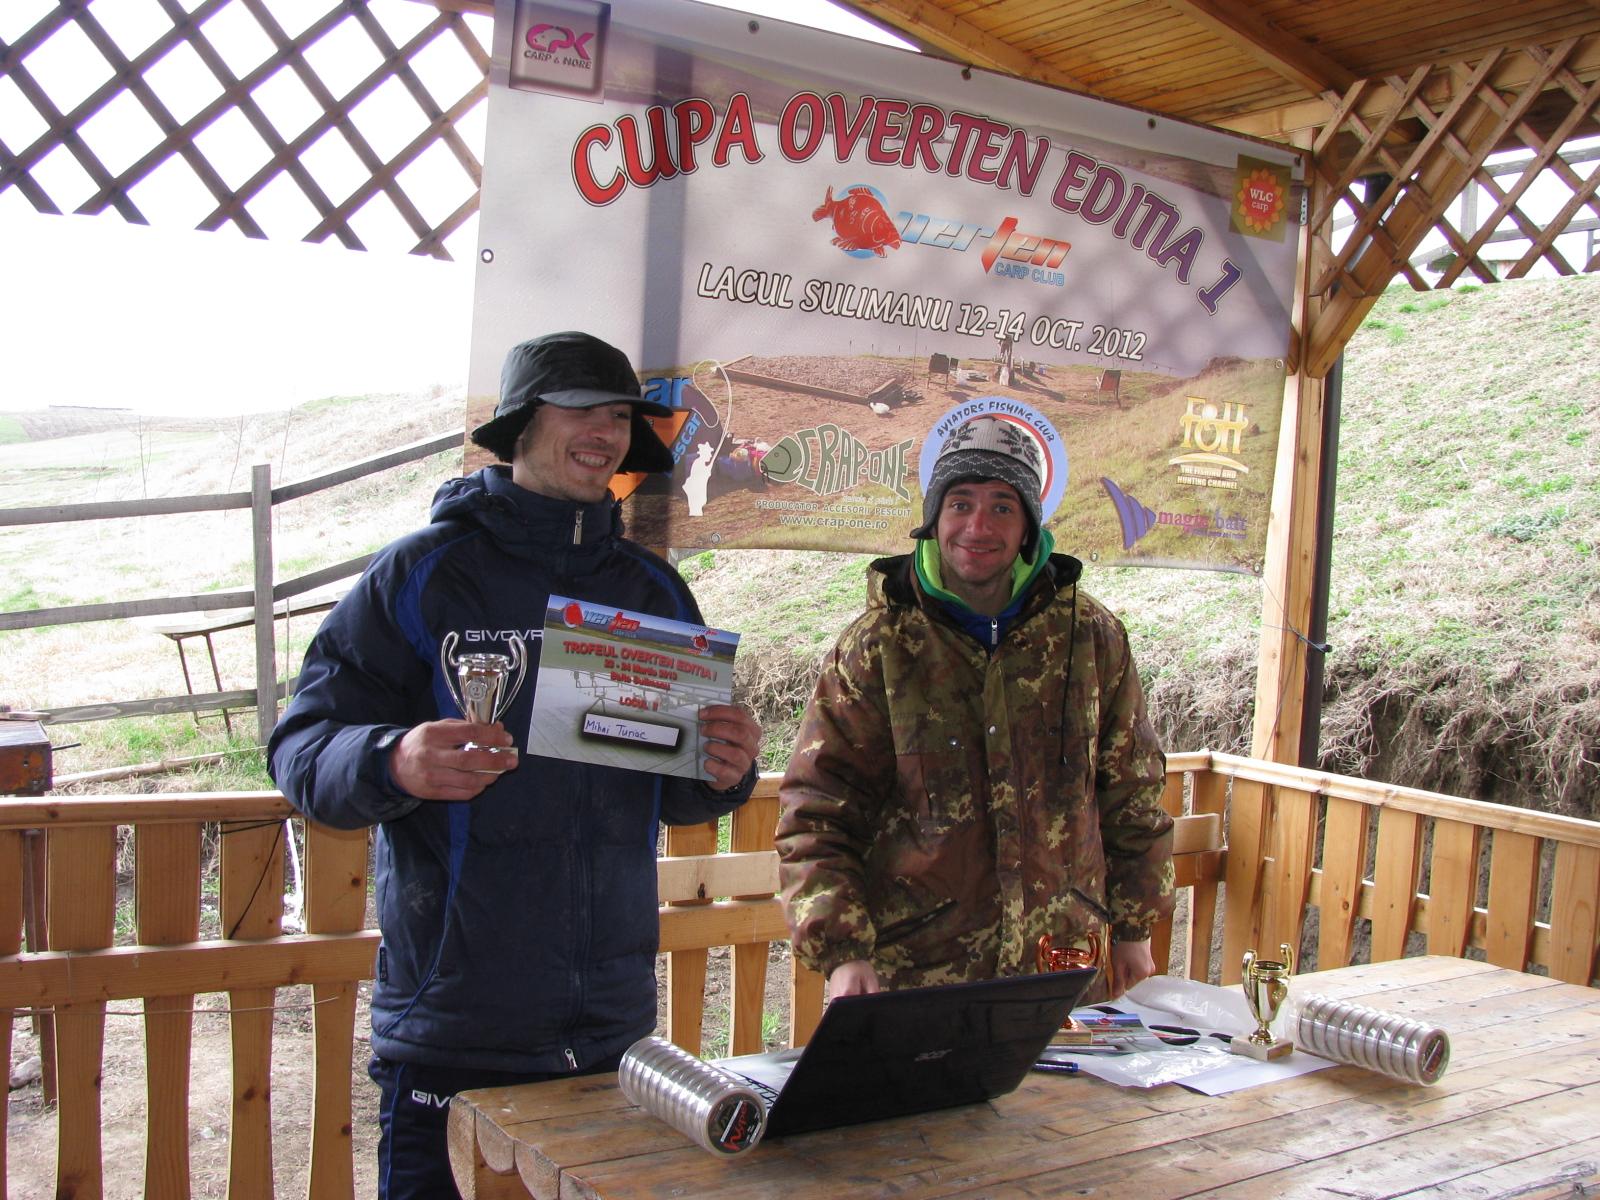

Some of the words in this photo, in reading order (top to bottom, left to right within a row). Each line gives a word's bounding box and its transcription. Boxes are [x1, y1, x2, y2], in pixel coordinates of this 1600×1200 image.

[524, 50, 552, 61] CARP
[571, 93, 765, 207] CUPA
[778, 91, 1051, 197] OVERTEN
[1051, 150, 1204, 284] EDITIA
[1250, 188, 1274, 202] WLC
[1251, 201, 1269, 213] carp
[994, 262, 1030, 280] CARP
[1031, 268, 1066, 287] CLUB
[697, 263, 793, 308] LACUL
[799, 280, 952, 331] SULIMANU
[956, 304, 1024, 341] 12-14
[1031, 316, 1081, 351] OCT.
[1087, 324, 1148, 361] 2012
[645, 377, 692, 407] ar
[937, 402, 984, 438] AVIATORS
[988, 401, 1033, 421] FISHING
[1034, 420, 1055, 442] CLUB
[1177, 475, 1207, 486] HUNTING
[1207, 479, 1238, 490] CHANNEL
[756, 501, 817, 511] PRODUCATOR
[875, 507, 911, 518] PESCUIT
[563, 640, 618, 658] TROFEUL
[620, 647, 674, 669] OVERTEN
[584, 720, 610, 735] Mihai
[412, 1089, 451, 1108] GIV
